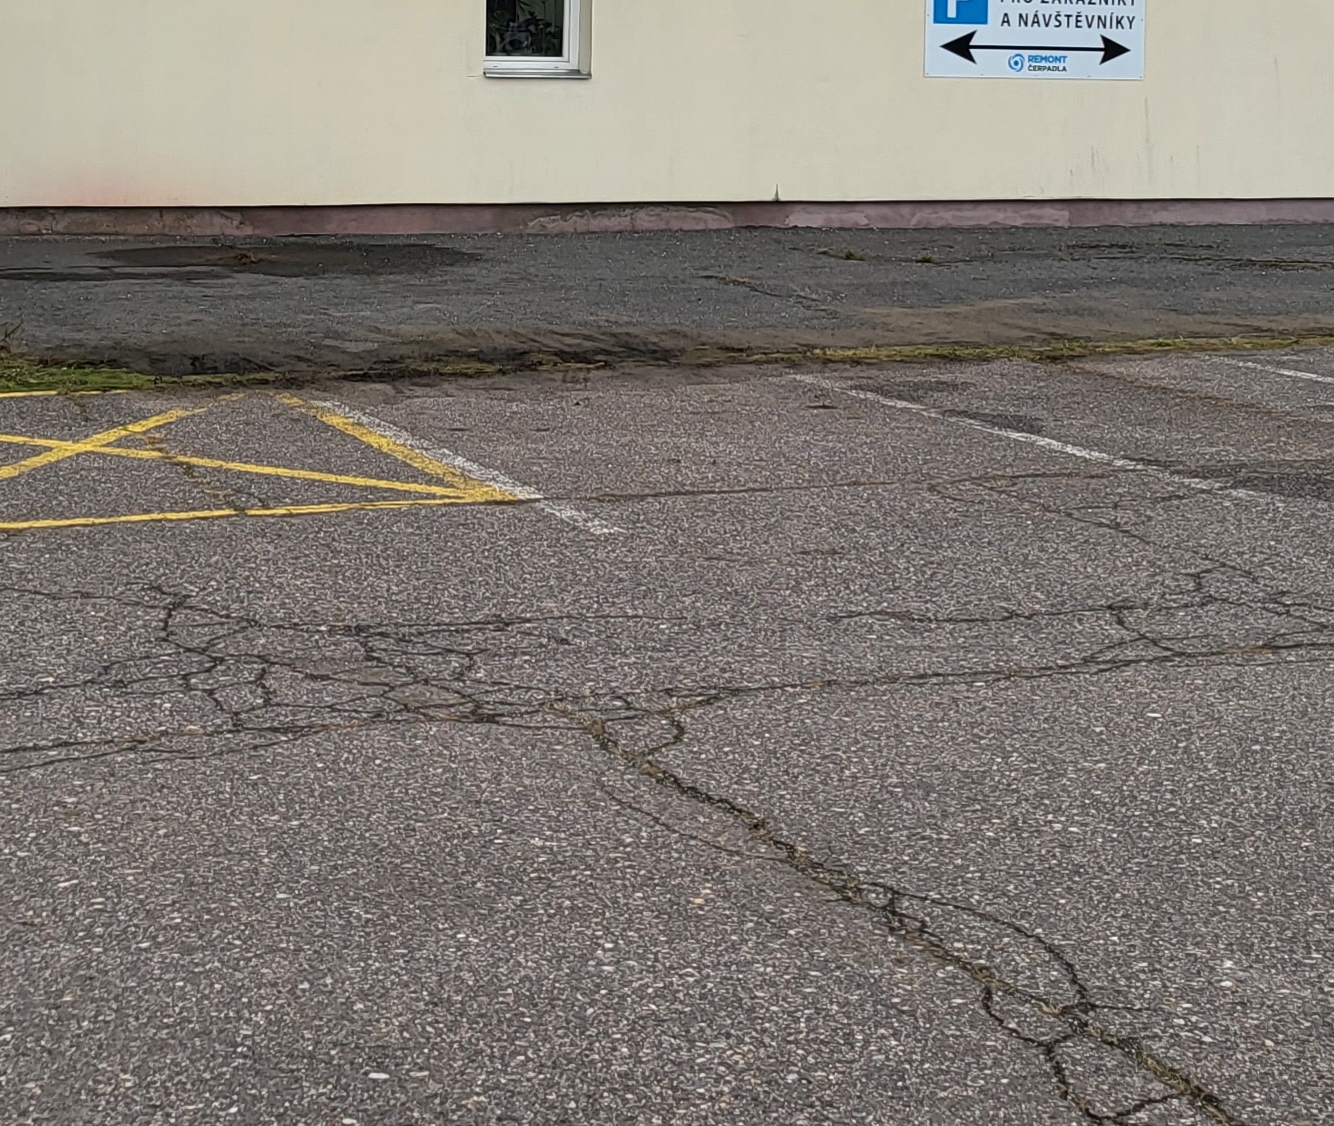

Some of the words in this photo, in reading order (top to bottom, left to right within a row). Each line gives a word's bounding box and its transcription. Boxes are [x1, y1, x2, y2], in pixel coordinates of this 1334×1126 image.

[1000, 12, 1011, 27] A
[1018, 9, 1136, 30] NÁVŠTĚVNÍKY
[1027, 54, 1068, 64] REMONT
[1027, 63, 1068, 72] ČERPADLA
